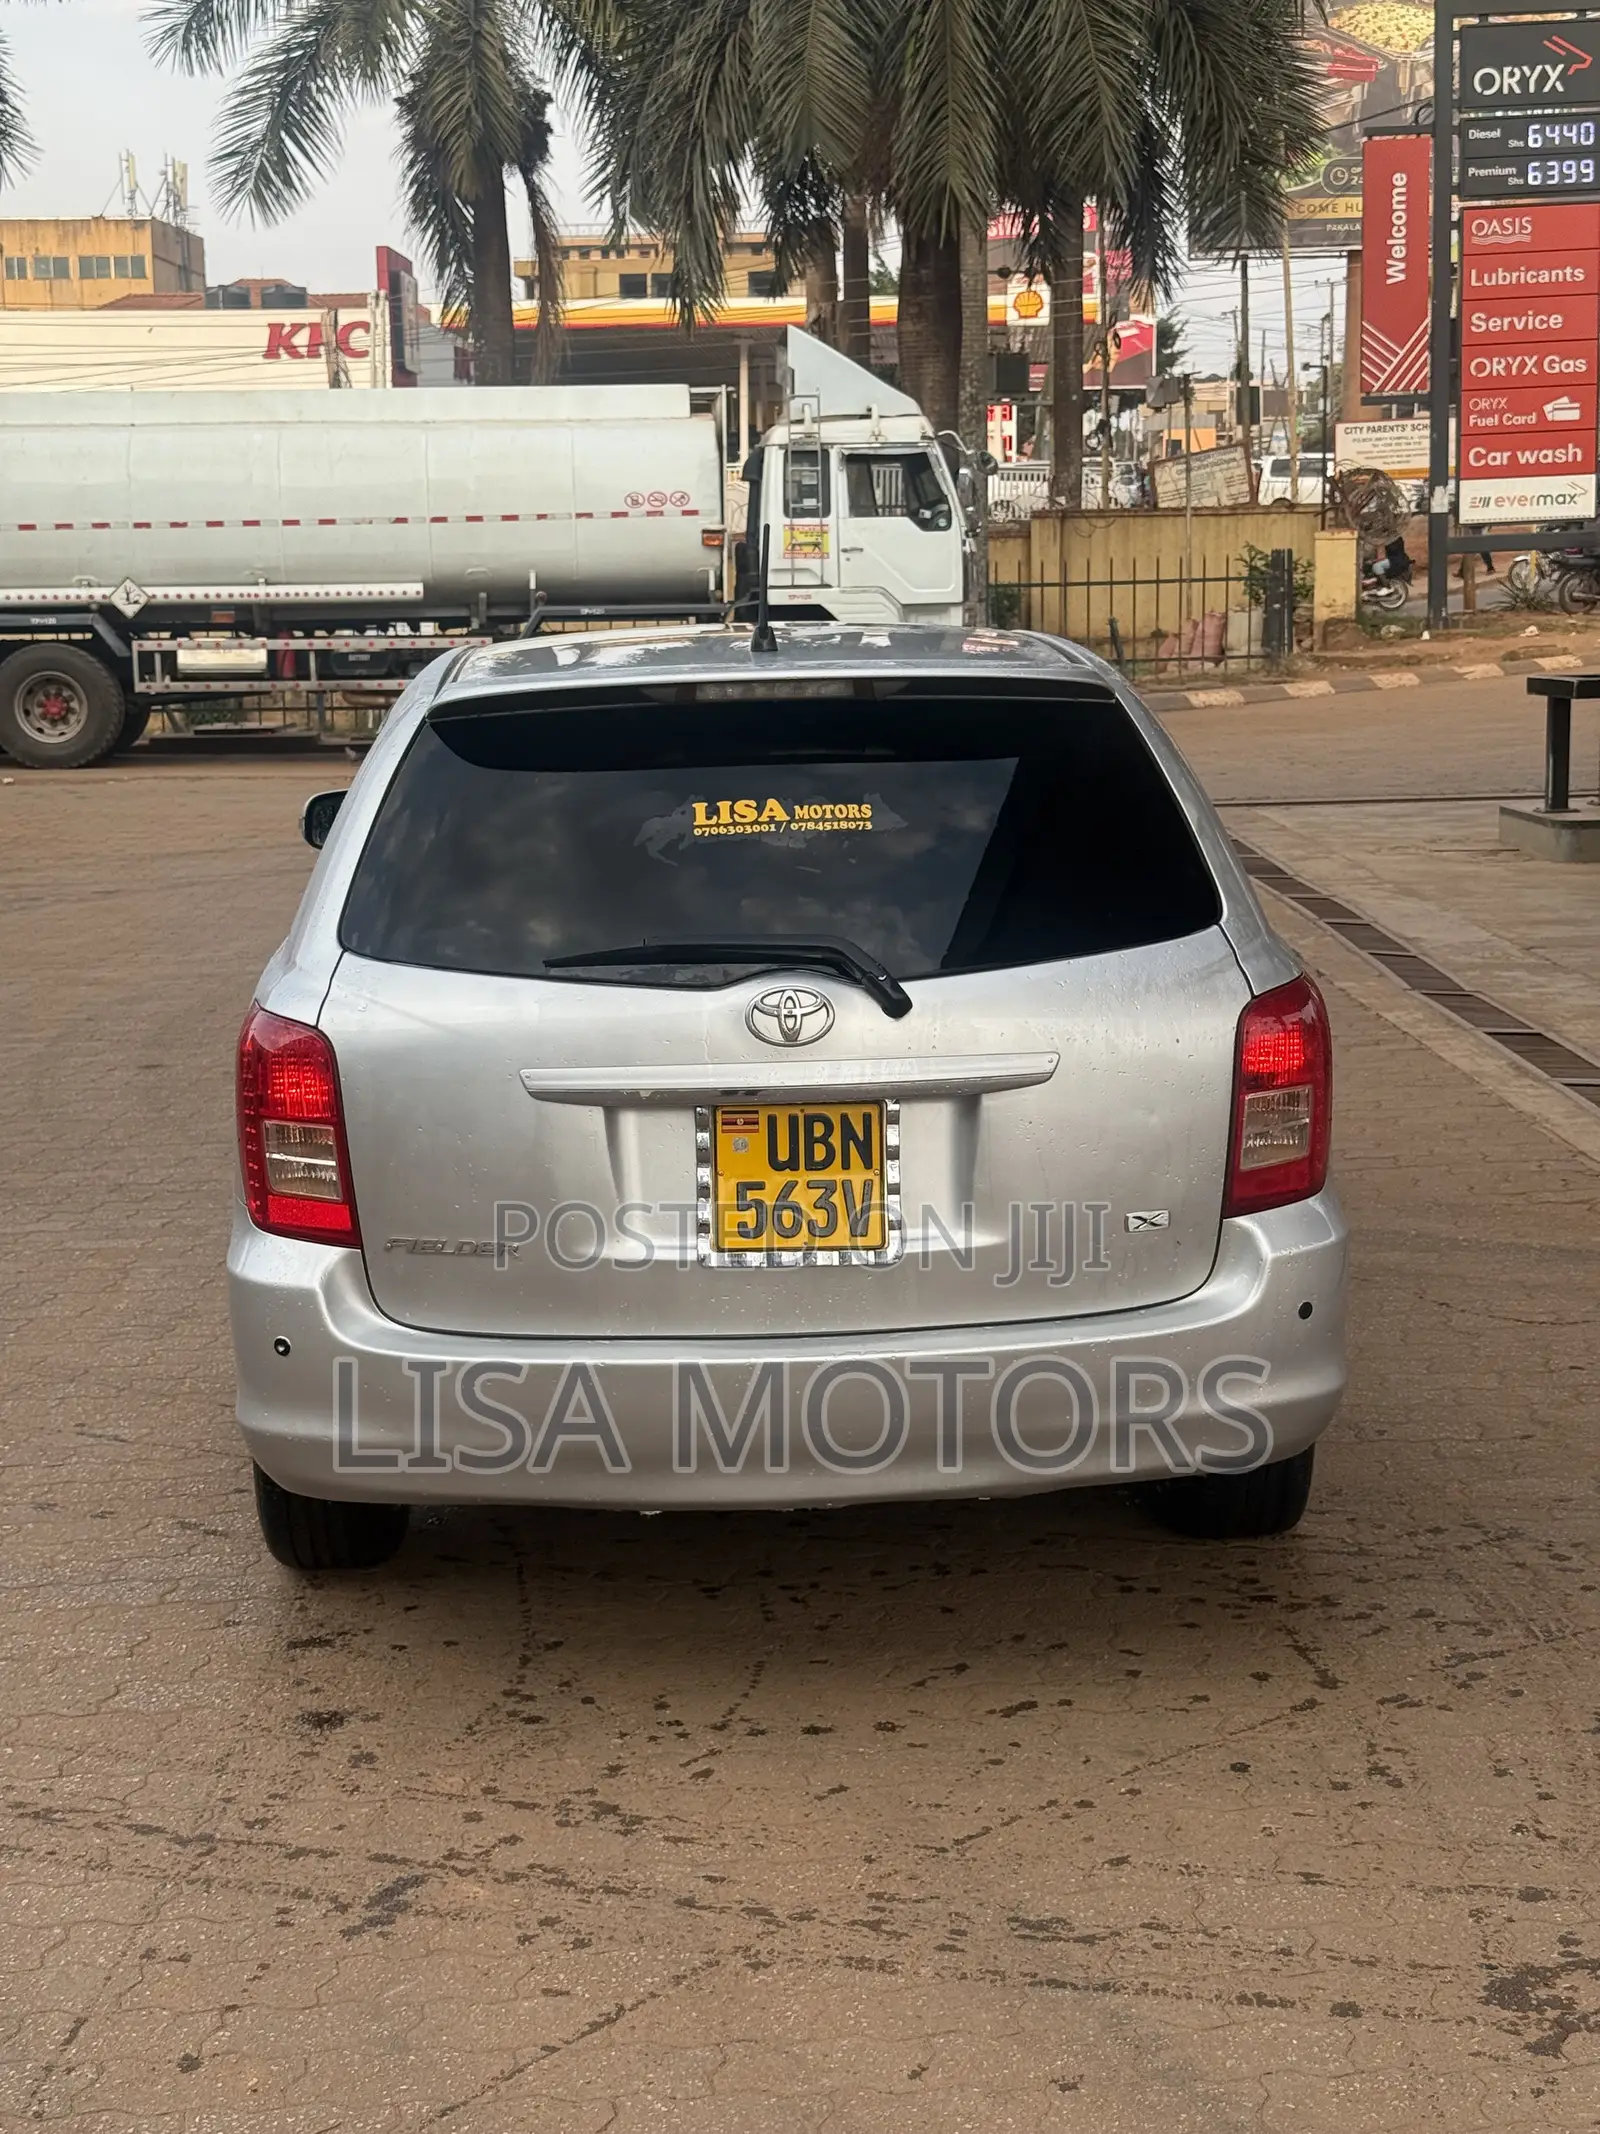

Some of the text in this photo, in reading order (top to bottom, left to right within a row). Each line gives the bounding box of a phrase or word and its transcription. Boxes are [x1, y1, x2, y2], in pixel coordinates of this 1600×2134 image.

[1473, 65, 1564, 96] ORYX
[1468, 121, 1595, 148] Diesel Shs 6440
[1468, 159, 1594, 186] Premium Shs 6399
[1386, 172, 1408, 285] Welcome
[1471, 216, 1533, 236] OASIS
[1470, 265, 1586, 287] Lubricants
[1470, 310, 1563, 333] Service
[1470, 355, 1588, 378] ORYX Gas
[1469, 397, 1508, 411] ORYX
[1344, 426, 1364, 435] CITY
[1469, 412, 1537, 427] Fuel Card
[1469, 443, 1582, 467] Car wash
[1494, 493, 1577, 508] evermax
[692, 798, 872, 826] LISA MOTORS
[693, 823, 776, 836] 0706303001
[790, 821, 873, 832] 0784518073
[767, 1112, 873, 1172] UBN
[736, 1179, 873, 1240] 563V
[384, 1236, 520, 1258] FIELDER
